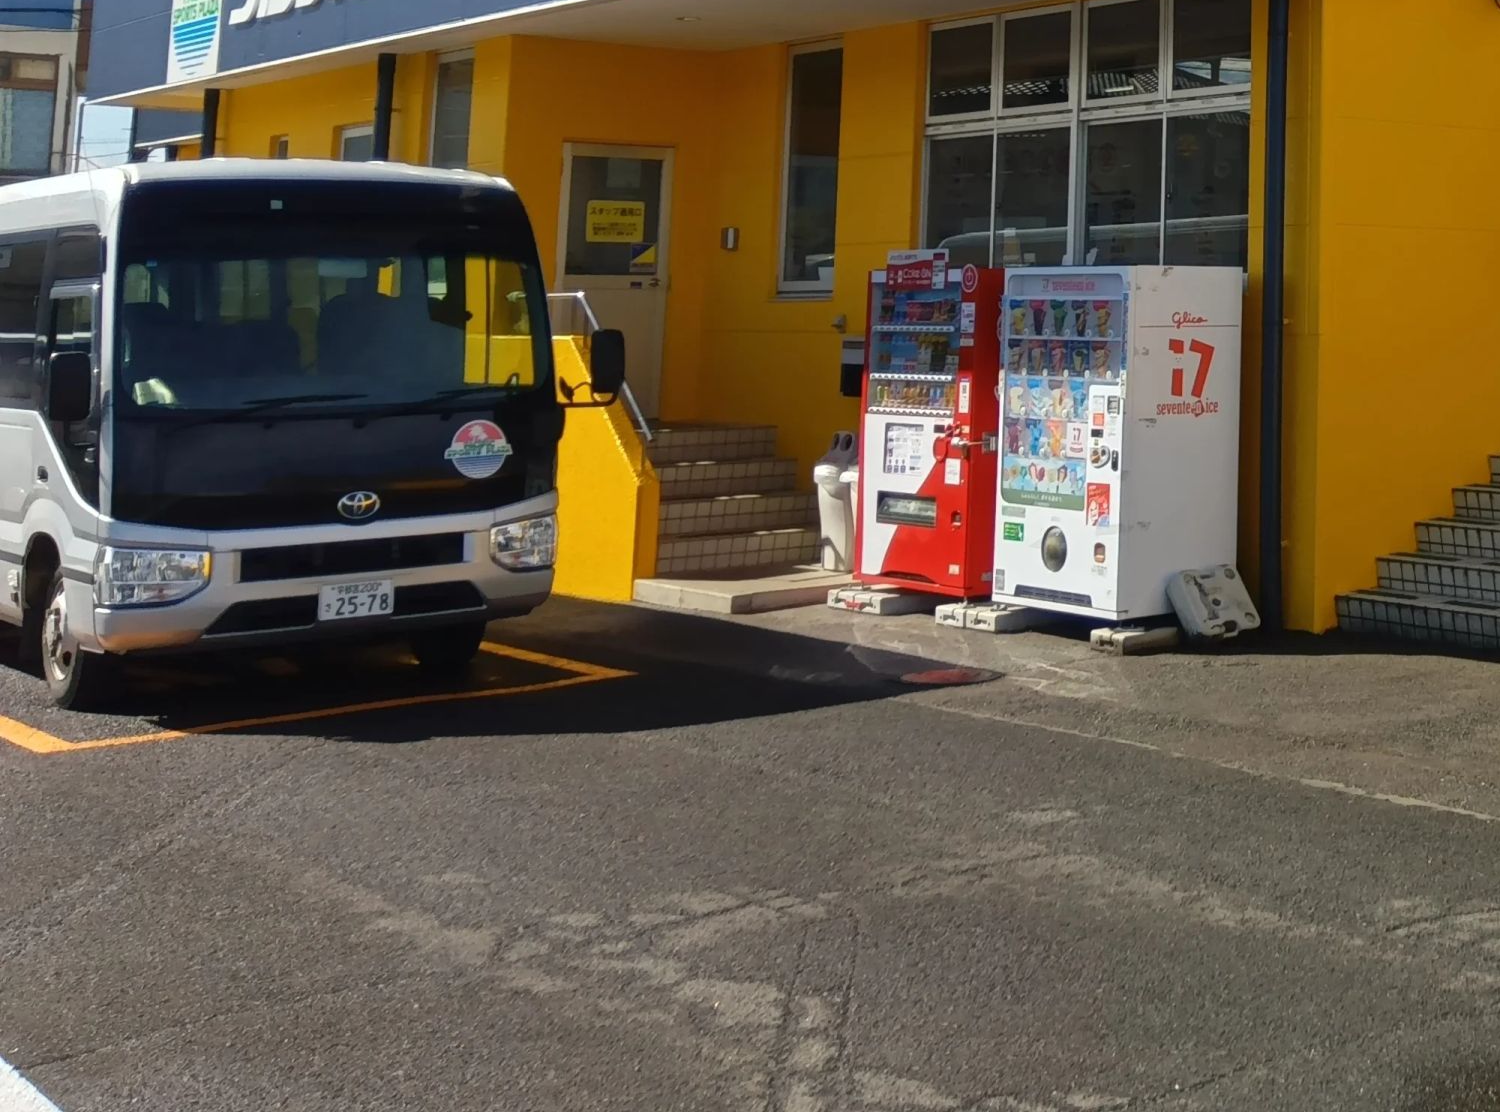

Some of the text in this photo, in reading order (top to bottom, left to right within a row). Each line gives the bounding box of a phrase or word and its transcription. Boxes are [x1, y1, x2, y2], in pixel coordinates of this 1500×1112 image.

[1172, 311, 1208, 329] Glico
[1205, 397, 1219, 414] ice
[335, 593, 389, 616] 25-78
